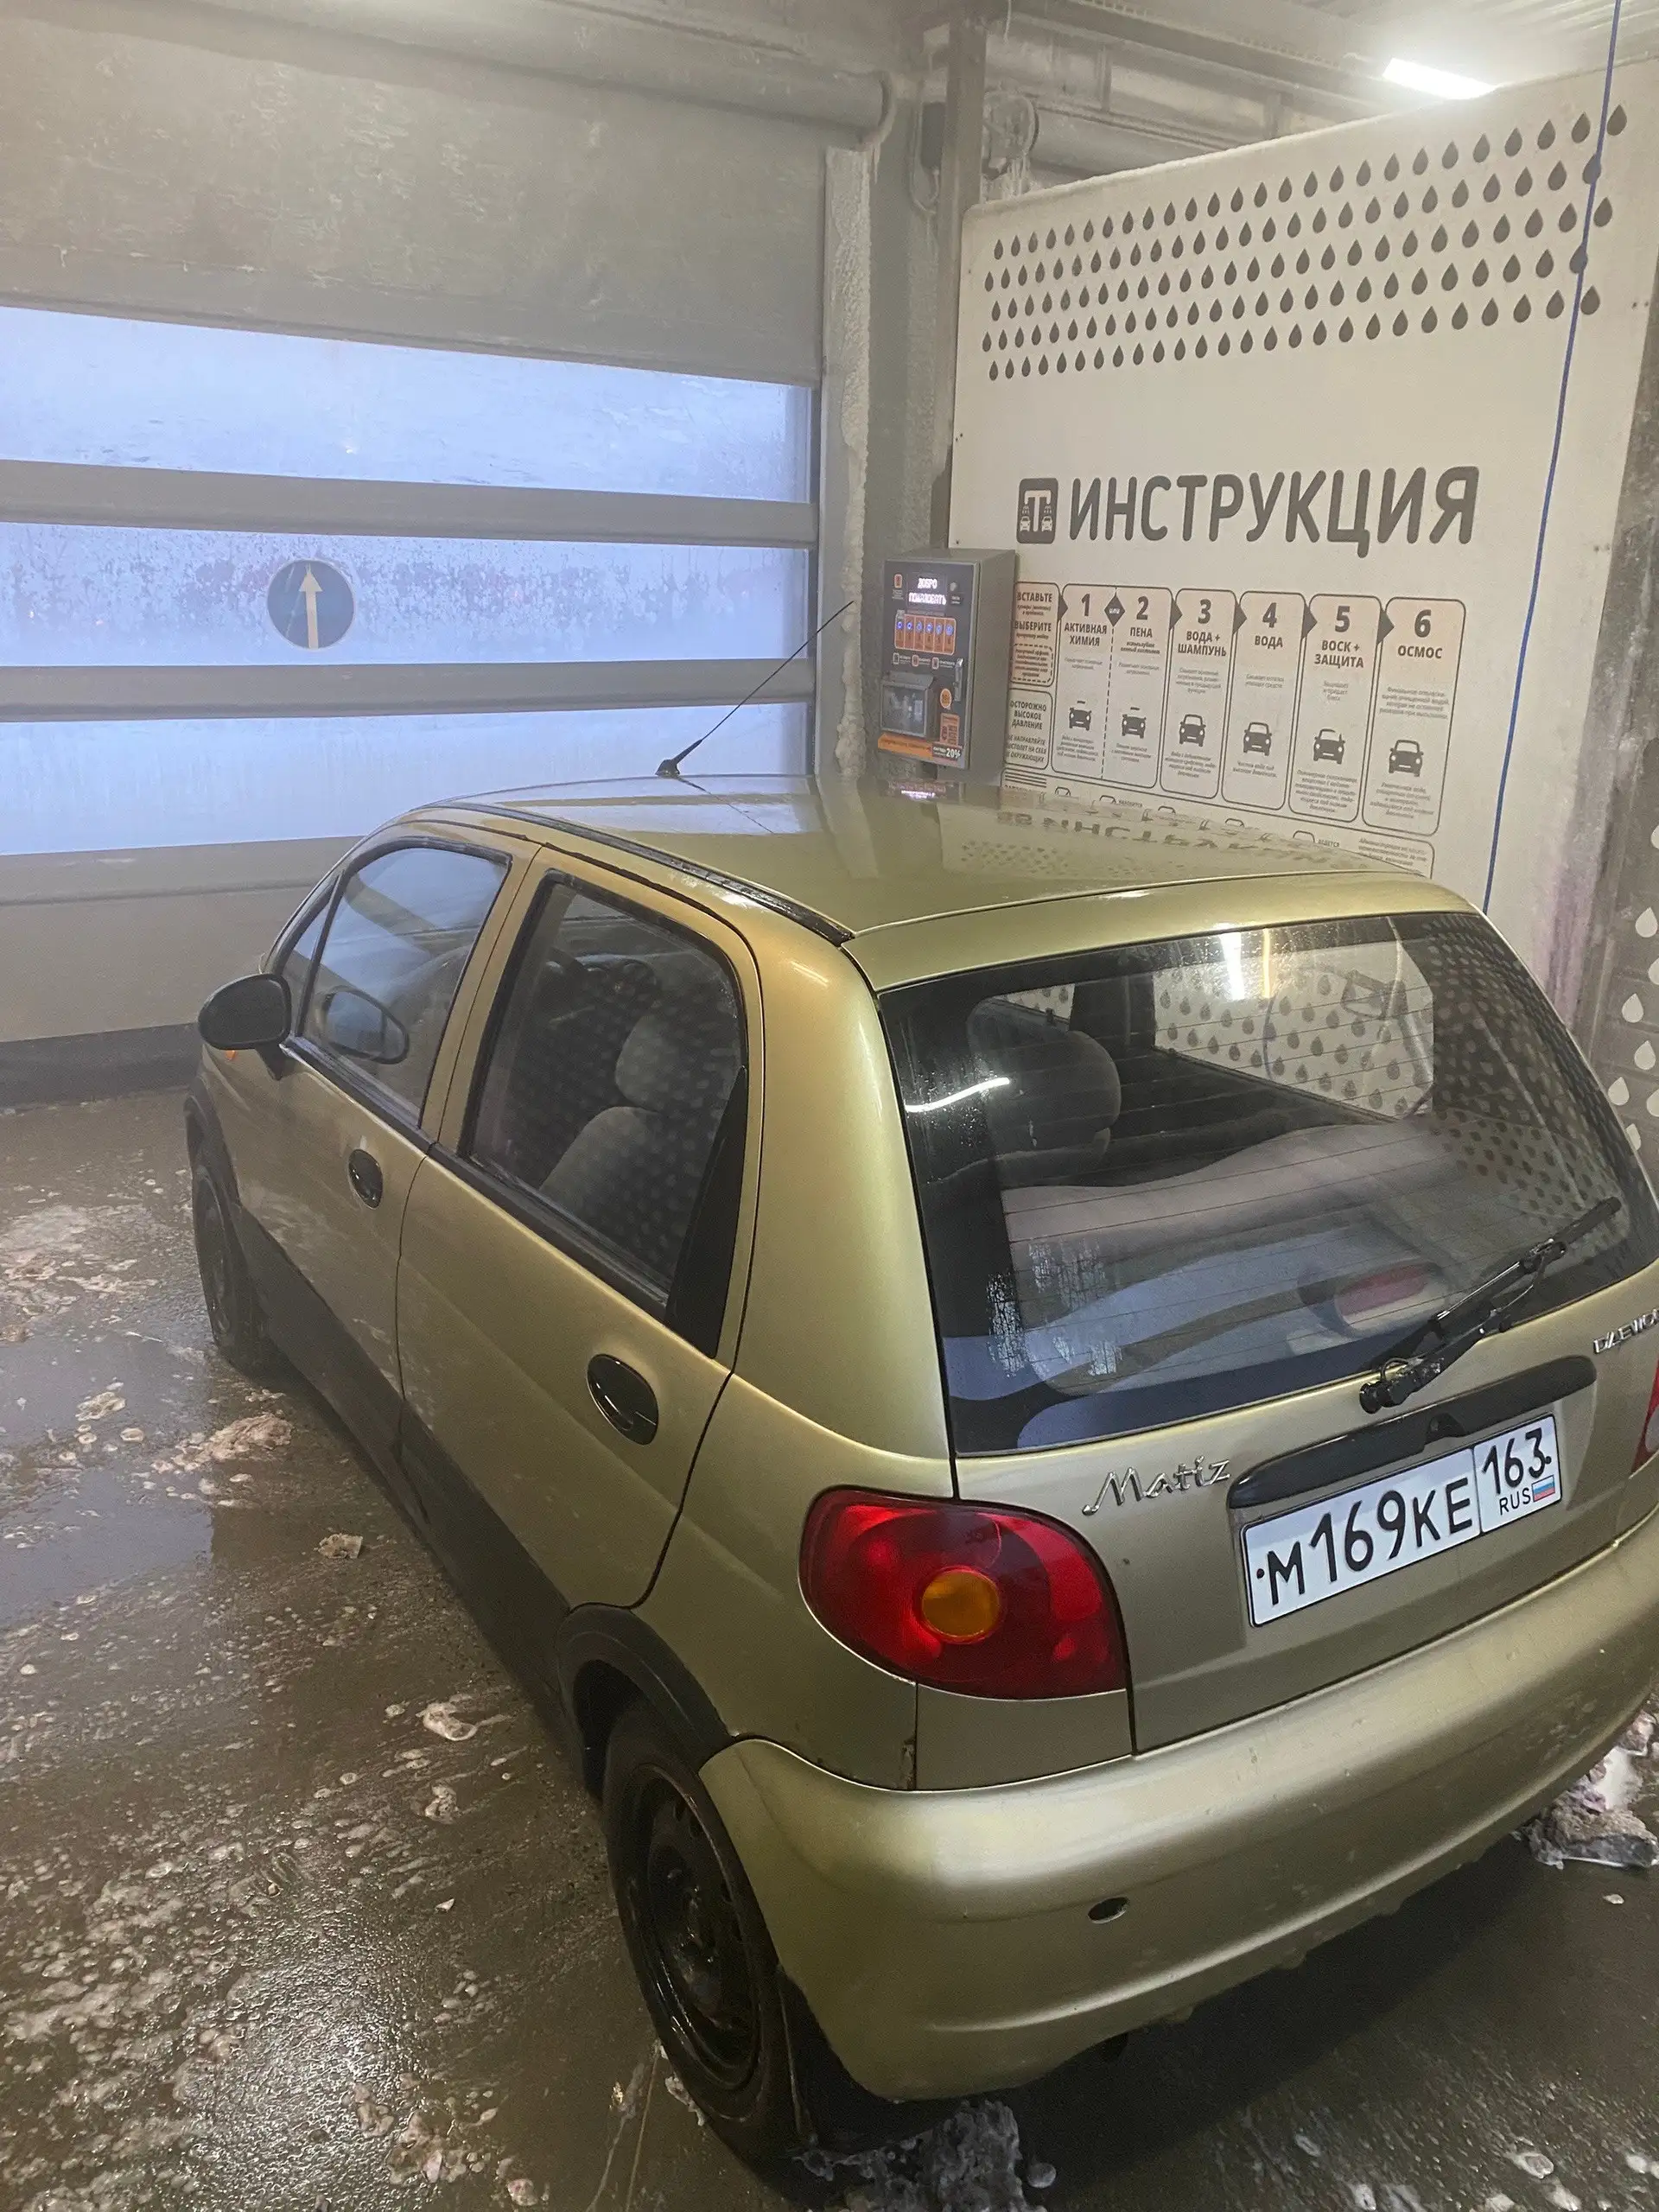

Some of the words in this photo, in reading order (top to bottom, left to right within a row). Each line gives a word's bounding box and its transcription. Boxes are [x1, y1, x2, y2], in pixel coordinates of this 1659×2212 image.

[1069, 467, 1479, 558] ИНСТРУКЦИЯ
[1016, 592, 1052, 602] ВСТАВЬТЕ
[1081, 594, 1090, 616] 1
[1136, 596, 1148, 620] 2
[1198, 599, 1211, 624] 3
[1262, 602, 1277, 628] 4
[1335, 606, 1350, 632] 5
[1014, 621, 1052, 632] ВЫБЕРИТЕ
[1065, 623, 1107, 634] АКТИВНАЯ
[1414, 609, 1431, 638] 6
[1130, 627, 1153, 638] ПЕНА
[1186, 631, 1212, 644] ВОДА
[1070, 635, 1100, 646] ХИМИЯ
[1255, 636, 1283, 650] ВОДА
[1322, 640, 1351, 652] ВОСК
[1178, 644, 1227, 657] ШАМПУНЬ
[1398, 645, 1443, 658] ОСМОС
[1314, 654, 1363, 668] ЗАЩИТА
[1009, 701, 1046, 711] ОСТОРОЖНО
[1014, 710, 1041, 720] ВЫСОКОЕ
[1012, 719, 1042, 729] ДАВЛЕНИЕ
[1482, 1427, 1546, 1495] 163
[1082, 1455, 1230, 1516] Matiz
[1499, 1487, 1531, 1516] RUS
